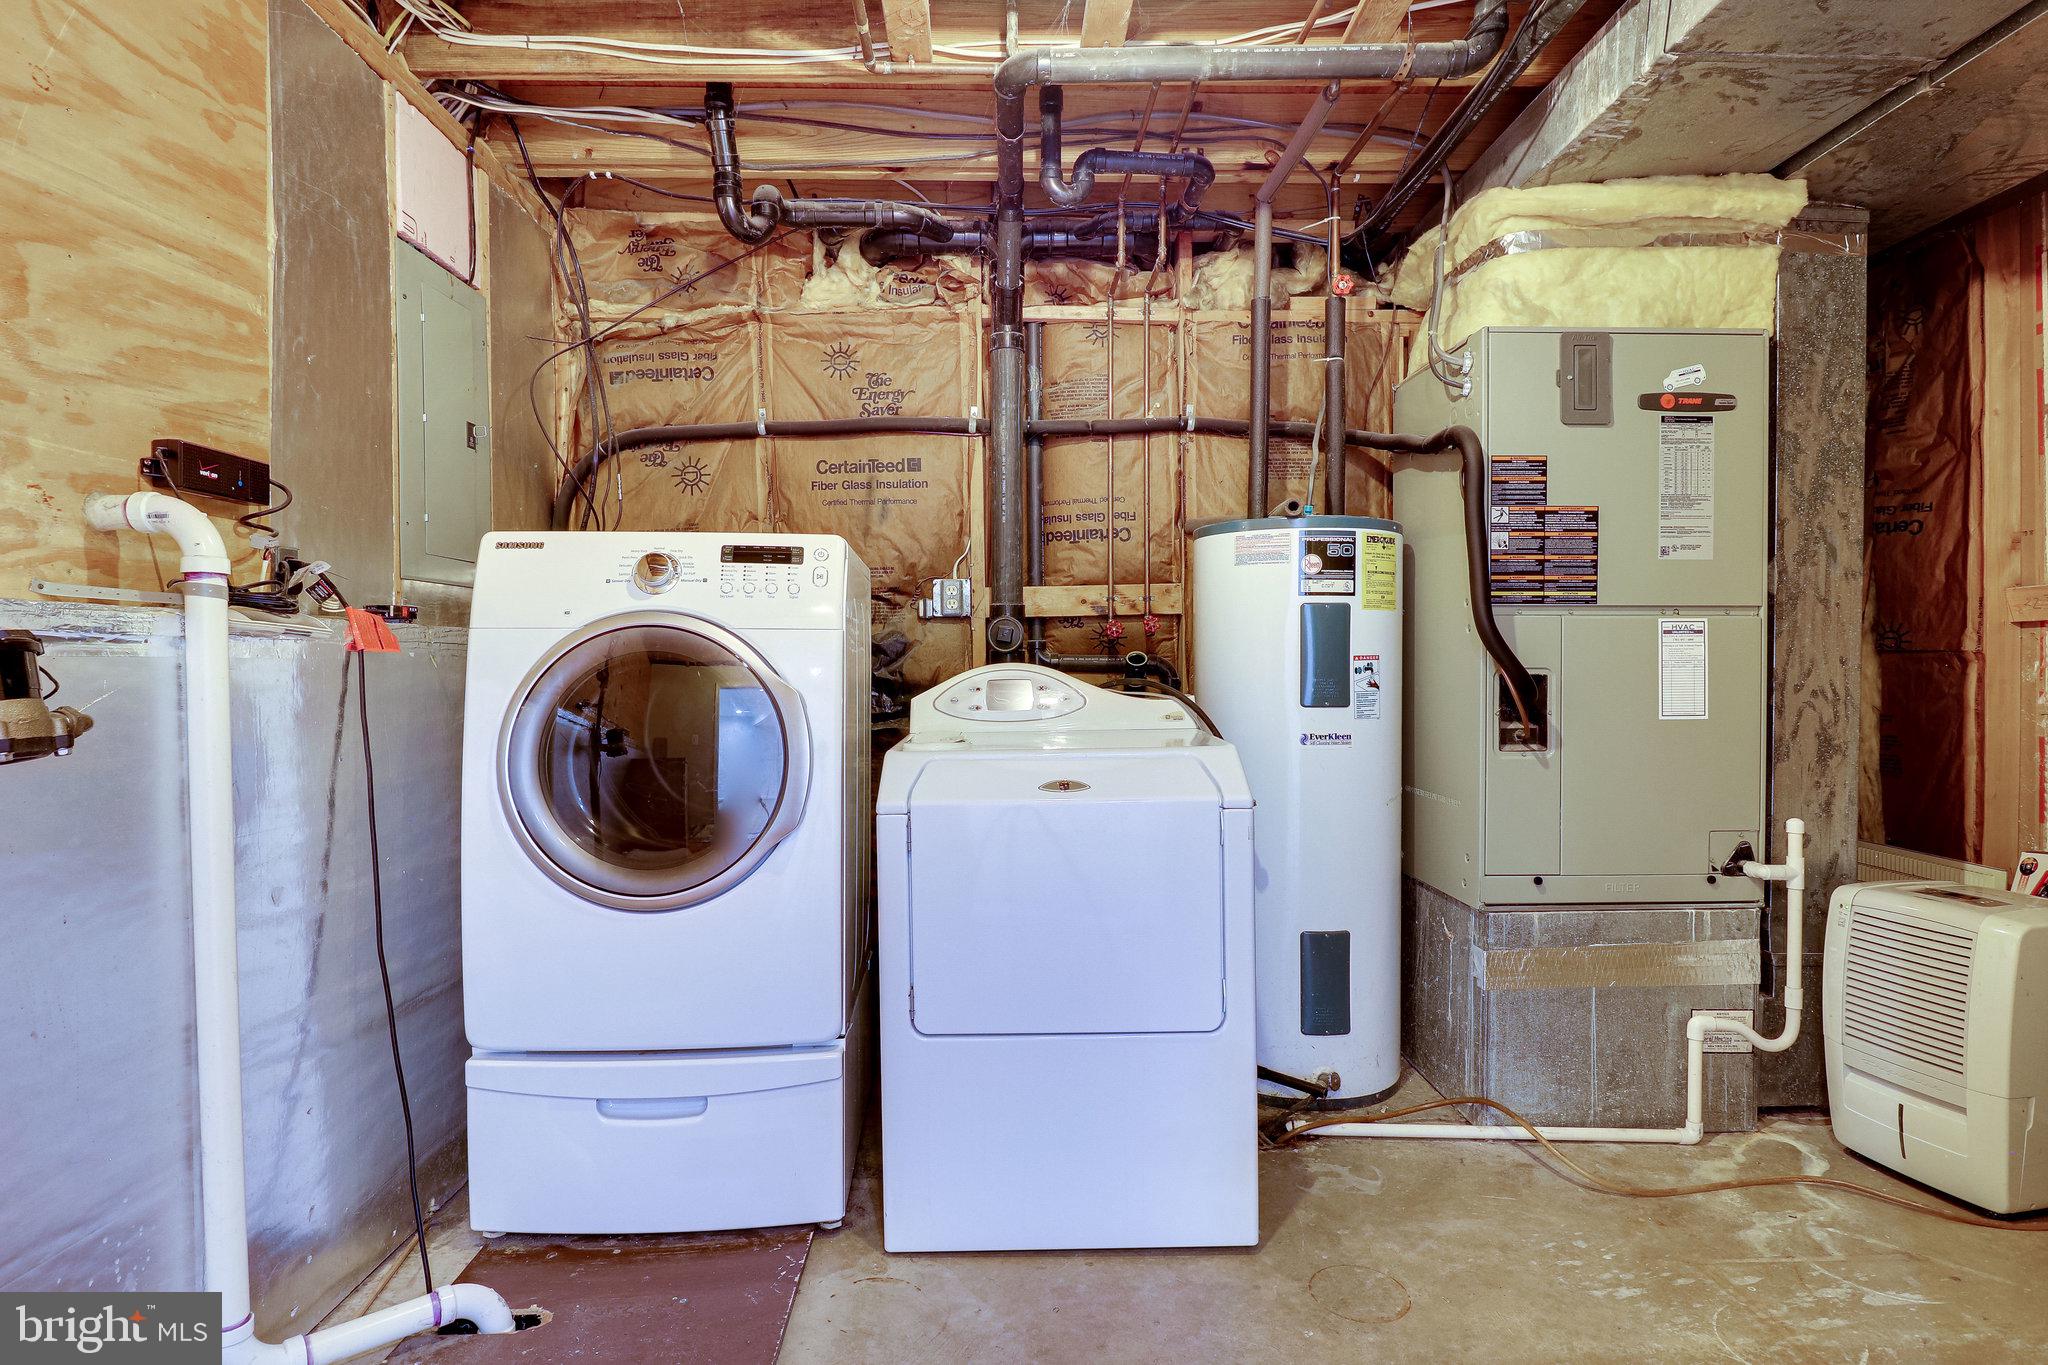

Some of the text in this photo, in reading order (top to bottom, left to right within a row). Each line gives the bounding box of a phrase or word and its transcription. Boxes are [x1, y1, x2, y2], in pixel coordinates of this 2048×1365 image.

[638, 254, 663, 272] The
[1271, 334, 1294, 344] lass
[603, 352, 655, 366] Insulation
[658, 351, 690, 361] Glass
[865, 372, 893, 389] The
[852, 387, 916, 404] Energy
[1677, 397, 1703, 405] TRANE
[859, 402, 903, 418] Saver
[816, 458, 905, 475] CertainTeed
[199, 469, 219, 479] verizon
[811, 478, 929, 491] Fiber Glass Insulation
[822, 497, 918, 507] Certified Thermal Performance
[1873, 505, 1898, 515] Gla
[1075, 511, 1105, 522] Glass
[1113, 511, 1136, 521] Fibe
[494, 541, 545, 550] SAMSUNG
[1327, 543, 1354, 557] 50
[1309, 733, 1352, 741] EverKleen
[1604, 883, 1641, 893] FILTER
